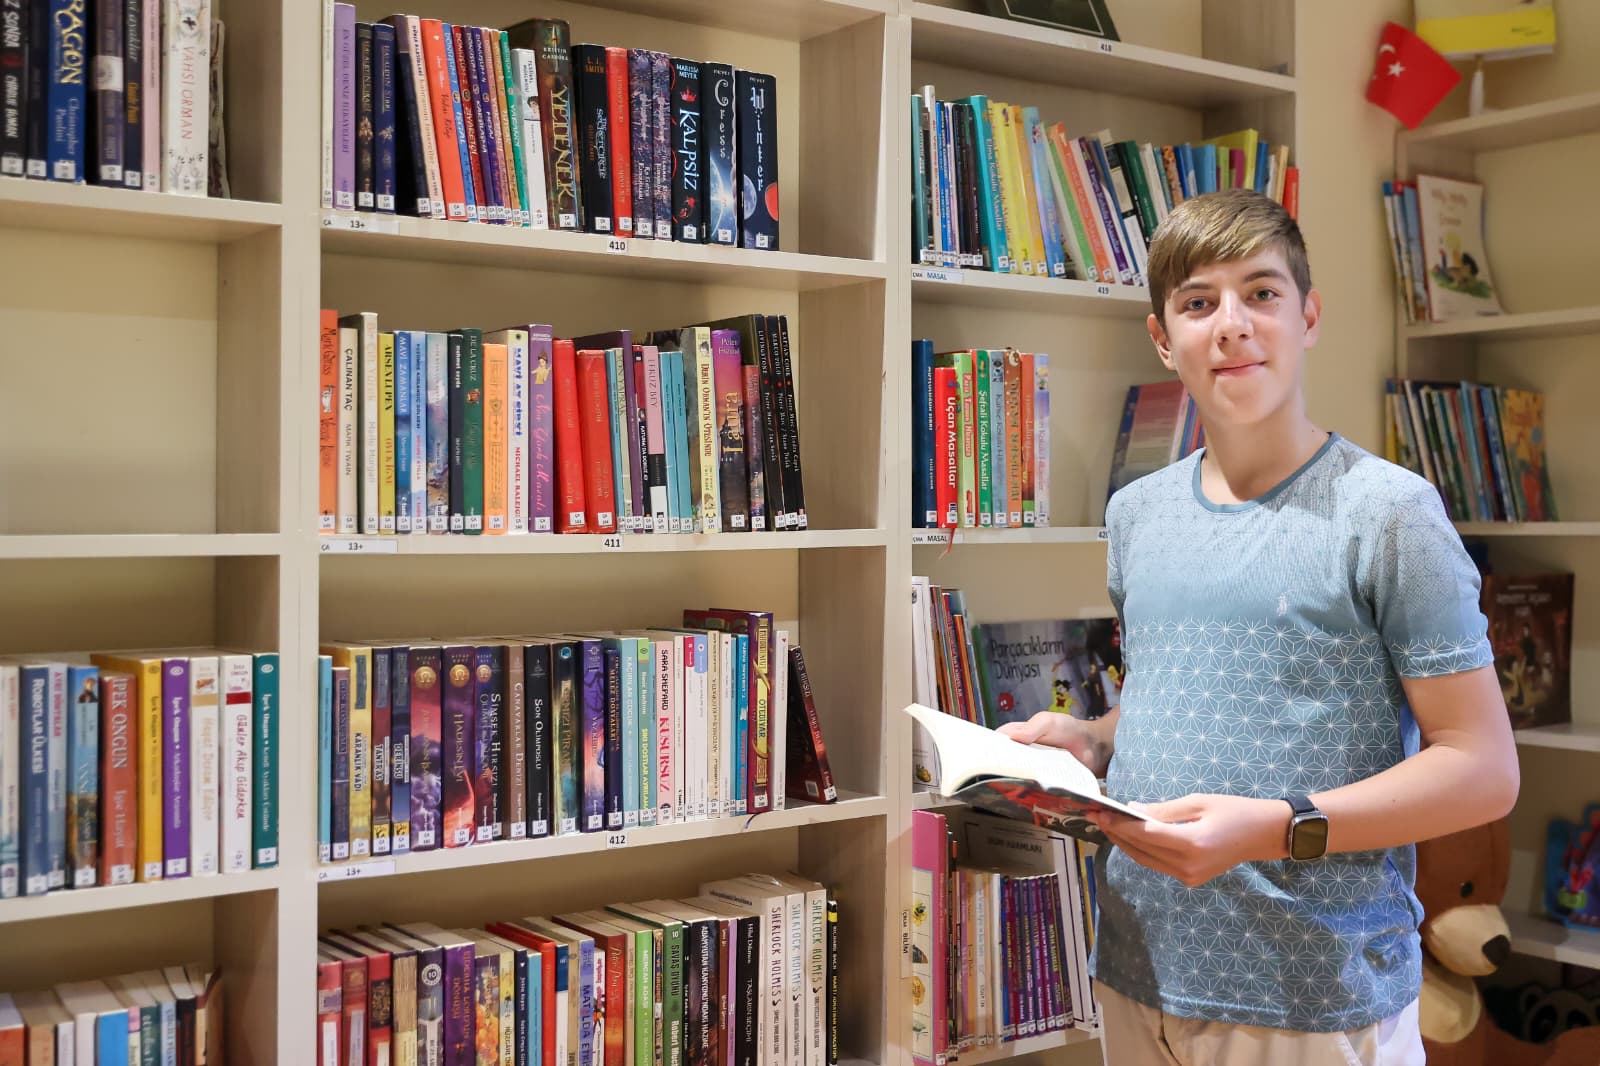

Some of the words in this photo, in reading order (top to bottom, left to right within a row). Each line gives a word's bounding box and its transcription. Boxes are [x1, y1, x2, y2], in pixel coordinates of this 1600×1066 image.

[1100, 43, 1112, 52] 418
[180, 90, 193, 140] ORMAN
[551, 85, 575, 200] YETENEK
[678, 108, 700, 191] KALPSİZ
[985, 139, 994, 160] Elma
[989, 162, 998, 192] Kokulu
[350, 220, 365, 229] 13+
[993, 195, 1002, 232] Masallar
[609, 240, 626, 250] 410
[926, 271, 947, 281] MASAL
[1097, 286, 1109, 294] 419
[399, 336, 409, 359] MAVİ
[470, 335, 477, 346] DE
[470, 348, 477, 359] LA
[757, 330, 767, 375] LIVINGSTONE
[781, 332, 790, 357] KAPTAN
[343, 348, 353, 389] ÇALINAN
[701, 363, 711, 385] DERİN
[783, 358, 791, 377] COOK
[343, 392, 353, 411] TAÇ
[399, 363, 408, 414] ZAMANLAR
[978, 390, 988, 417] Şeftali
[945, 397, 957, 428] Uçan
[533, 428, 548, 460] York
[979, 420, 988, 451] Kokulu
[946, 431, 957, 488] Masallar
[979, 452, 989, 490] Masallar
[348, 542, 363, 551] 13+
[604, 538, 621, 548] 411
[927, 535, 947, 543] MASAL
[661, 649, 669, 671] SARA
[990, 636, 1064, 660] Parçacıkların
[995, 661, 1041, 681] Dünyası
[31, 678, 46, 734] ROBOTLAR
[112, 678, 129, 709] İPEK
[661, 673, 669, 711] SHEPARD
[514, 682, 524, 749] CANAVARLAR
[534, 698, 544, 719] SON
[112, 713, 128, 768] ONGUN
[235, 714, 246, 746] Günler
[534, 721, 545, 770] OLİMPOSLU
[31, 737, 47, 774] ÜLKESİ
[235, 750, 246, 772] Akıp
[353, 732, 362, 770] KARANLIK
[375, 744, 384, 780] TANTRAS
[491, 742, 501, 787] HIRSIZI
[659, 717, 670, 793] KUSURSUZ
[514, 752, 524, 786] DENİZİ
[235, 776, 245, 819] Giderken
[609, 835, 626, 845] 412
[346, 867, 361, 876] 13+
[771, 907, 782, 954] SHERLOCK
[791, 903, 801, 950] SHERLOCK
[811, 899, 821, 944] SHERLOCK
[669, 944, 680, 969] SAVAŞ
[811, 948, 821, 983] HOLMES
[771, 959, 781, 996] HOLMES
[791, 956, 800, 993] HOLMES
[671, 1020, 679, 1046] Robert
